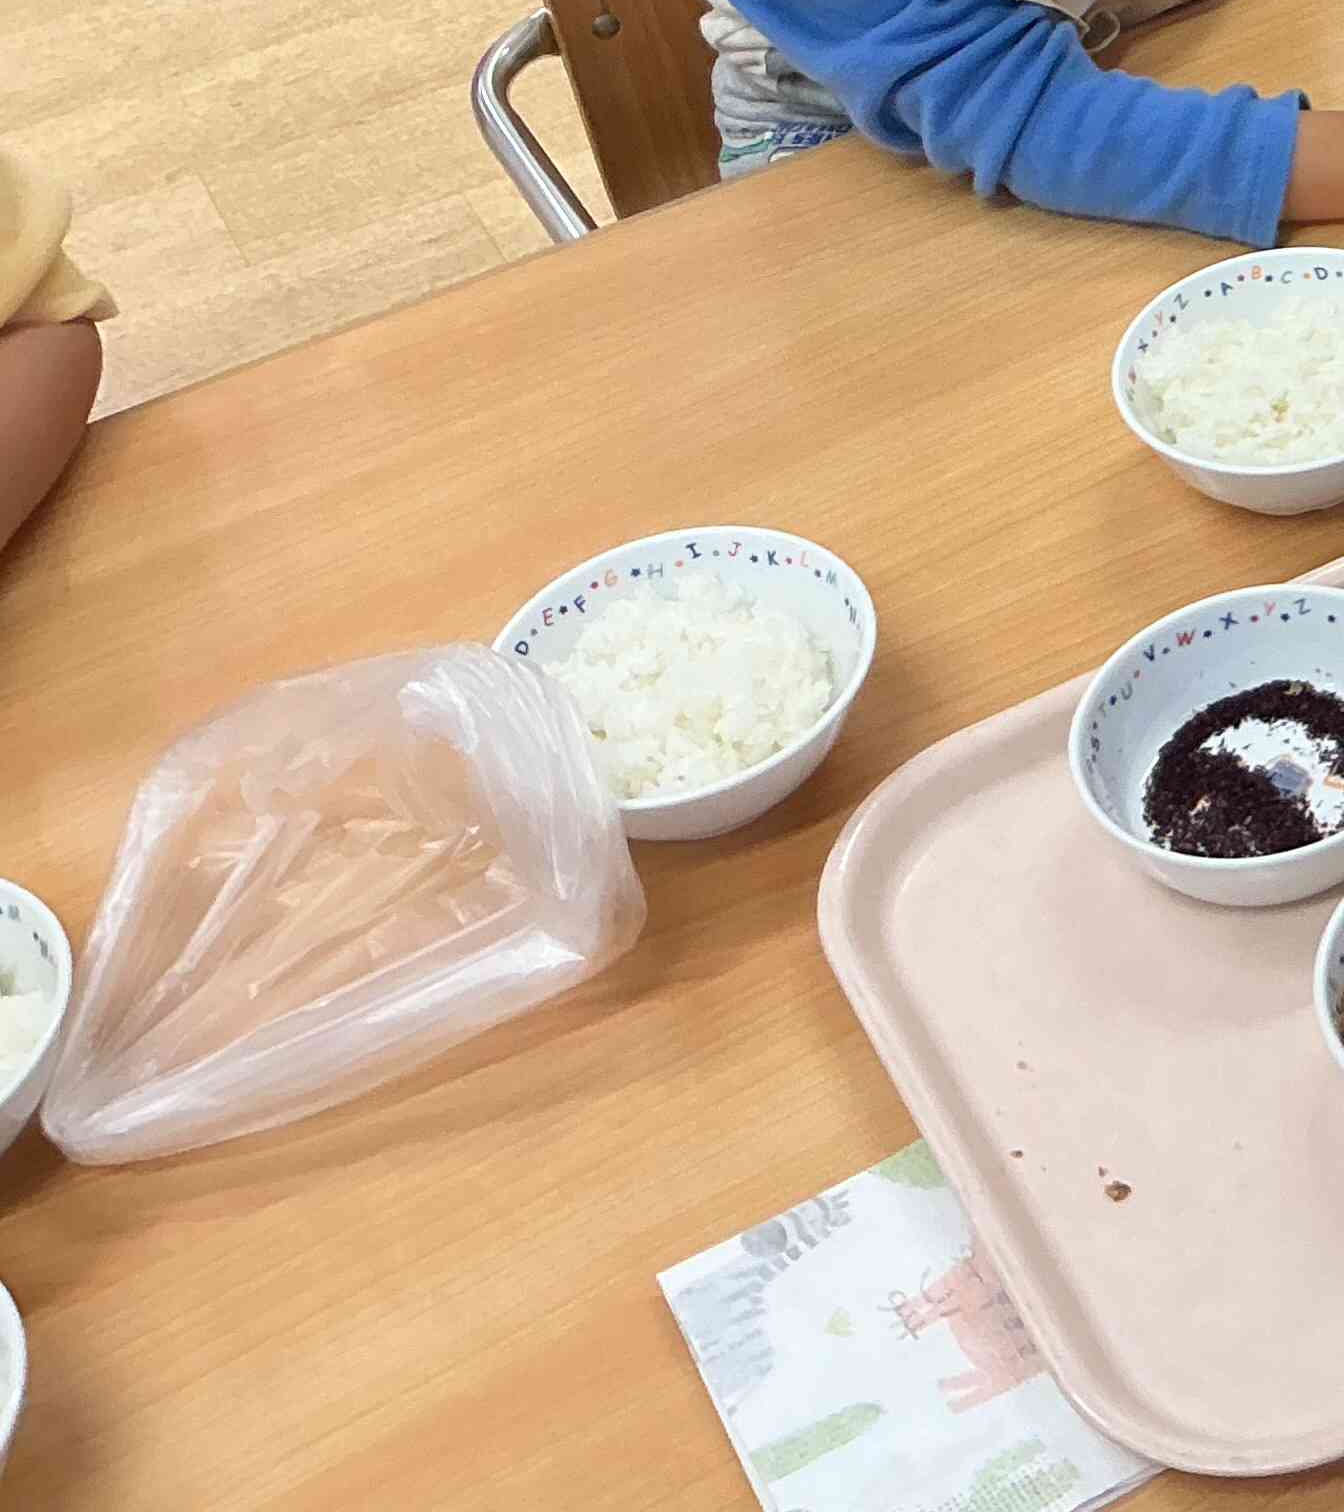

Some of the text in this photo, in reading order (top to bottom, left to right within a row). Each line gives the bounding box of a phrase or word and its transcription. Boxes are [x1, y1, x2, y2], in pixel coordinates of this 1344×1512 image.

[1174, 294, 1189, 310] Z
[1221, 282, 1233, 296] A
[1251, 265, 1262, 280] B
[1281, 271, 1293, 284] C
[1314, 267, 1329, 280] D
[514, 640, 529, 656] D
[542, 608, 554, 626] E
[573, 595, 586, 613] F
[604, 569, 618, 587] G
[647, 563, 663, 579] H
[686, 542, 702, 559] I
[728, 542, 742, 557] J
[767, 550, 780, 566] K
[800, 551, 809, 567] L
[1143, 644, 1155, 662] V
[1176, 629, 1197, 647] W
[1219, 612, 1240, 630] X
[1264, 601, 1276, 616] Y
[1294, 598, 1312, 615] Z
